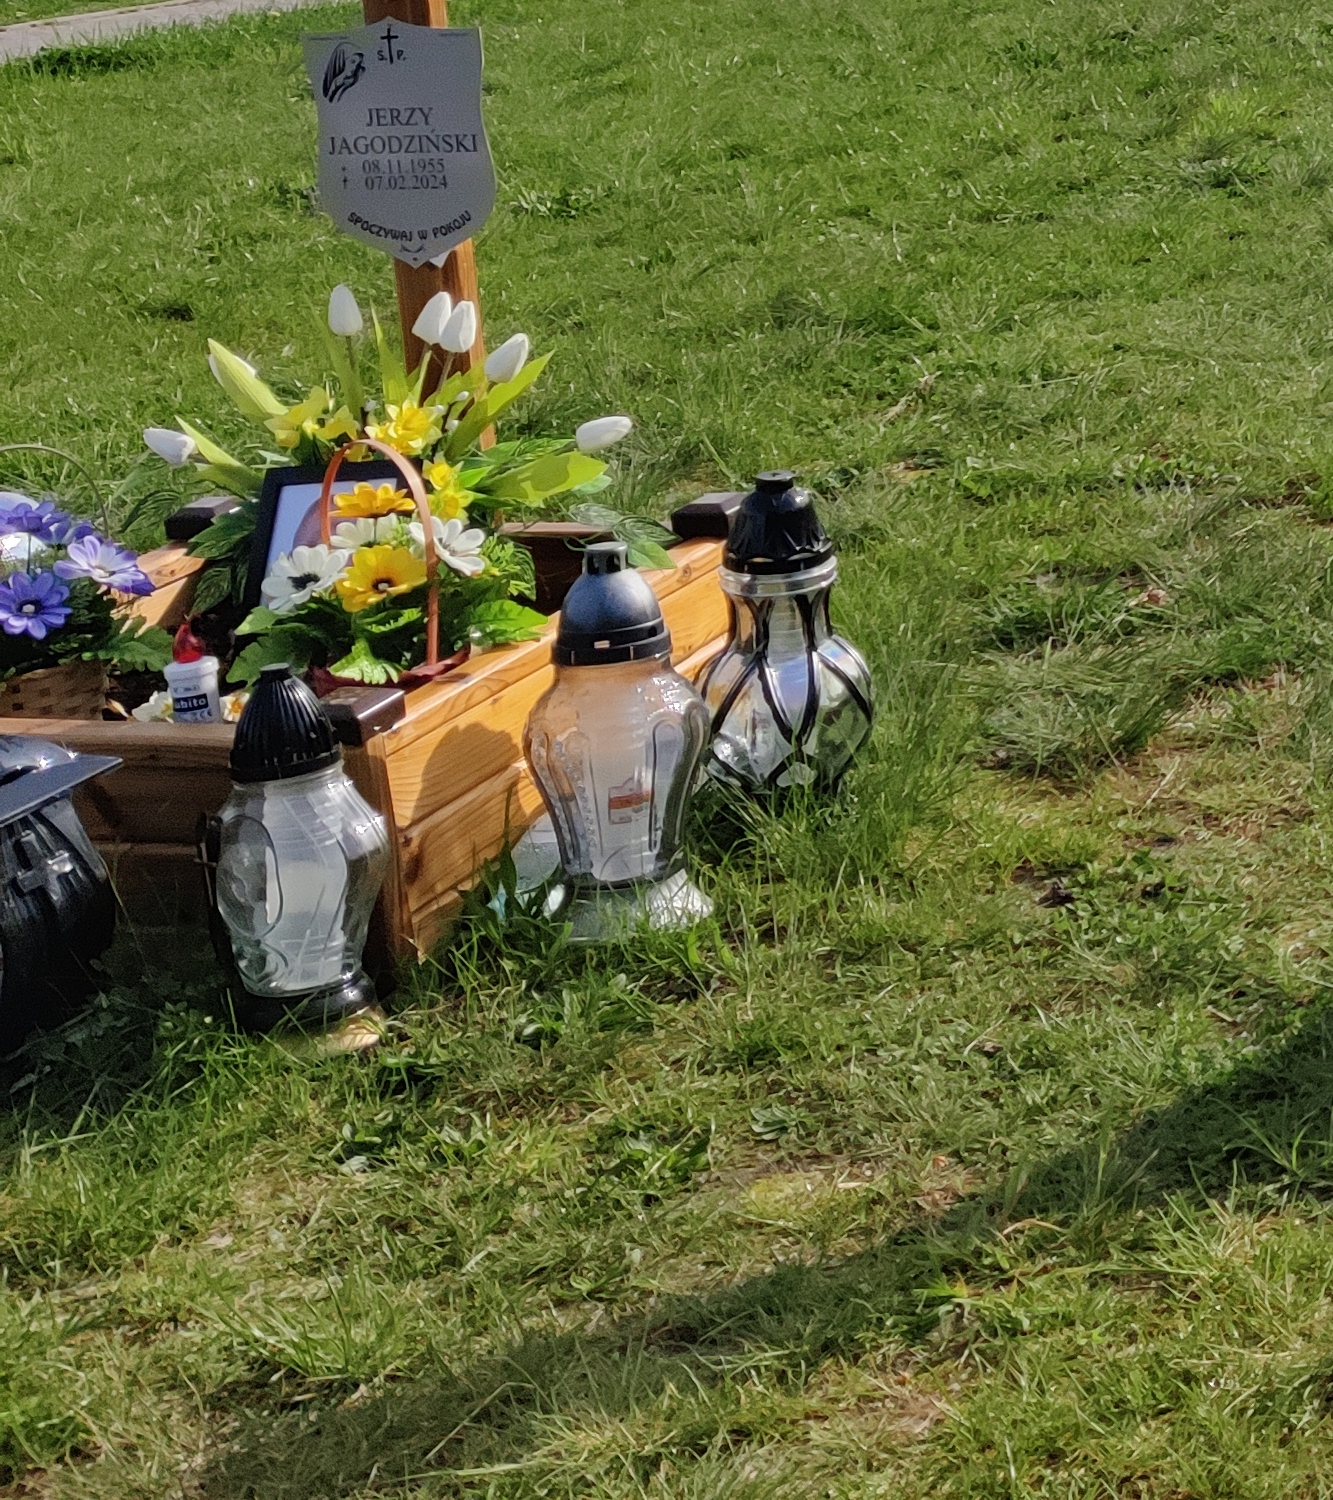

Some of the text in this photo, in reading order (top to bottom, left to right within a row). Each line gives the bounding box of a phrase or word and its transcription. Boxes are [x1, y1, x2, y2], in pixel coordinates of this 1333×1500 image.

[365, 107, 433, 127] JERZY
[328, 128, 479, 155] JAGODZIŃSKI
[362, 158, 445, 175] 08.11.1955
[364, 174, 448, 190] 07.02.2024
[347, 209, 472, 242] SPOCZYWAJ W POKOJU
